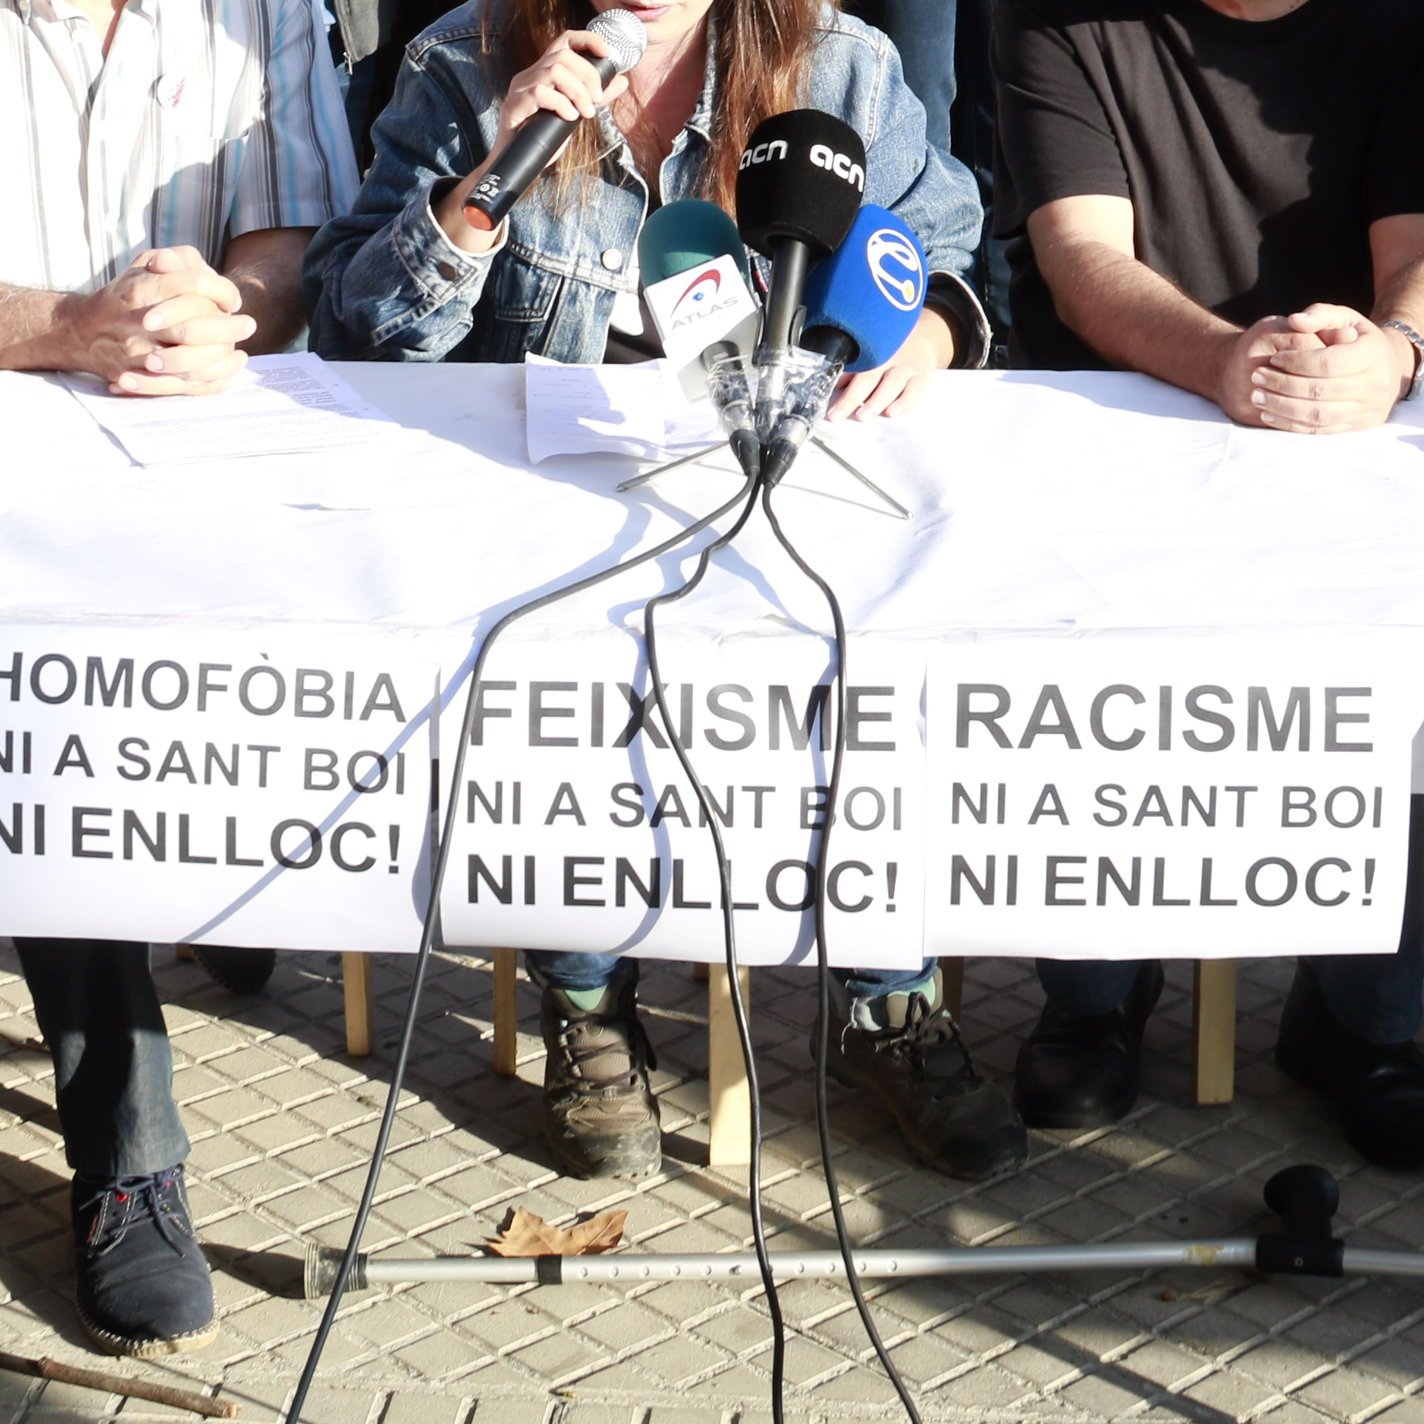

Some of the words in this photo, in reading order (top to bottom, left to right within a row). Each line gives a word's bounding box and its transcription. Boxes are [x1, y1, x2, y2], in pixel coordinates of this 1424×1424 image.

[739, 140, 789, 171] acn
[809, 144, 865, 193] acn
[671, 296, 739, 331] ATLAS
[471, 681, 896, 751] FEIXISME
[956, 683, 1373, 752] RACISME
[53, 734, 95, 778] A
[116, 737, 281, 788] SANT
[304, 748, 405, 791] BOI
[467, 780, 521, 824] NI
[544, 782, 586, 826] A
[608, 786, 776, 828] SANT
[799, 787, 901, 831] BOI
[952, 782, 1006, 824] NI
[1028, 784, 1070, 825] A
[1093, 783, 1258, 827] SANT
[1281, 786, 1382, 828] BOI
[72, 806, 400, 874] ENLLOC!
[468, 854, 535, 905] NI
[563, 856, 897, 913] ENLLOC!
[950, 855, 1018, 906] NI
[1045, 856, 1375, 907] ENLLOC!
